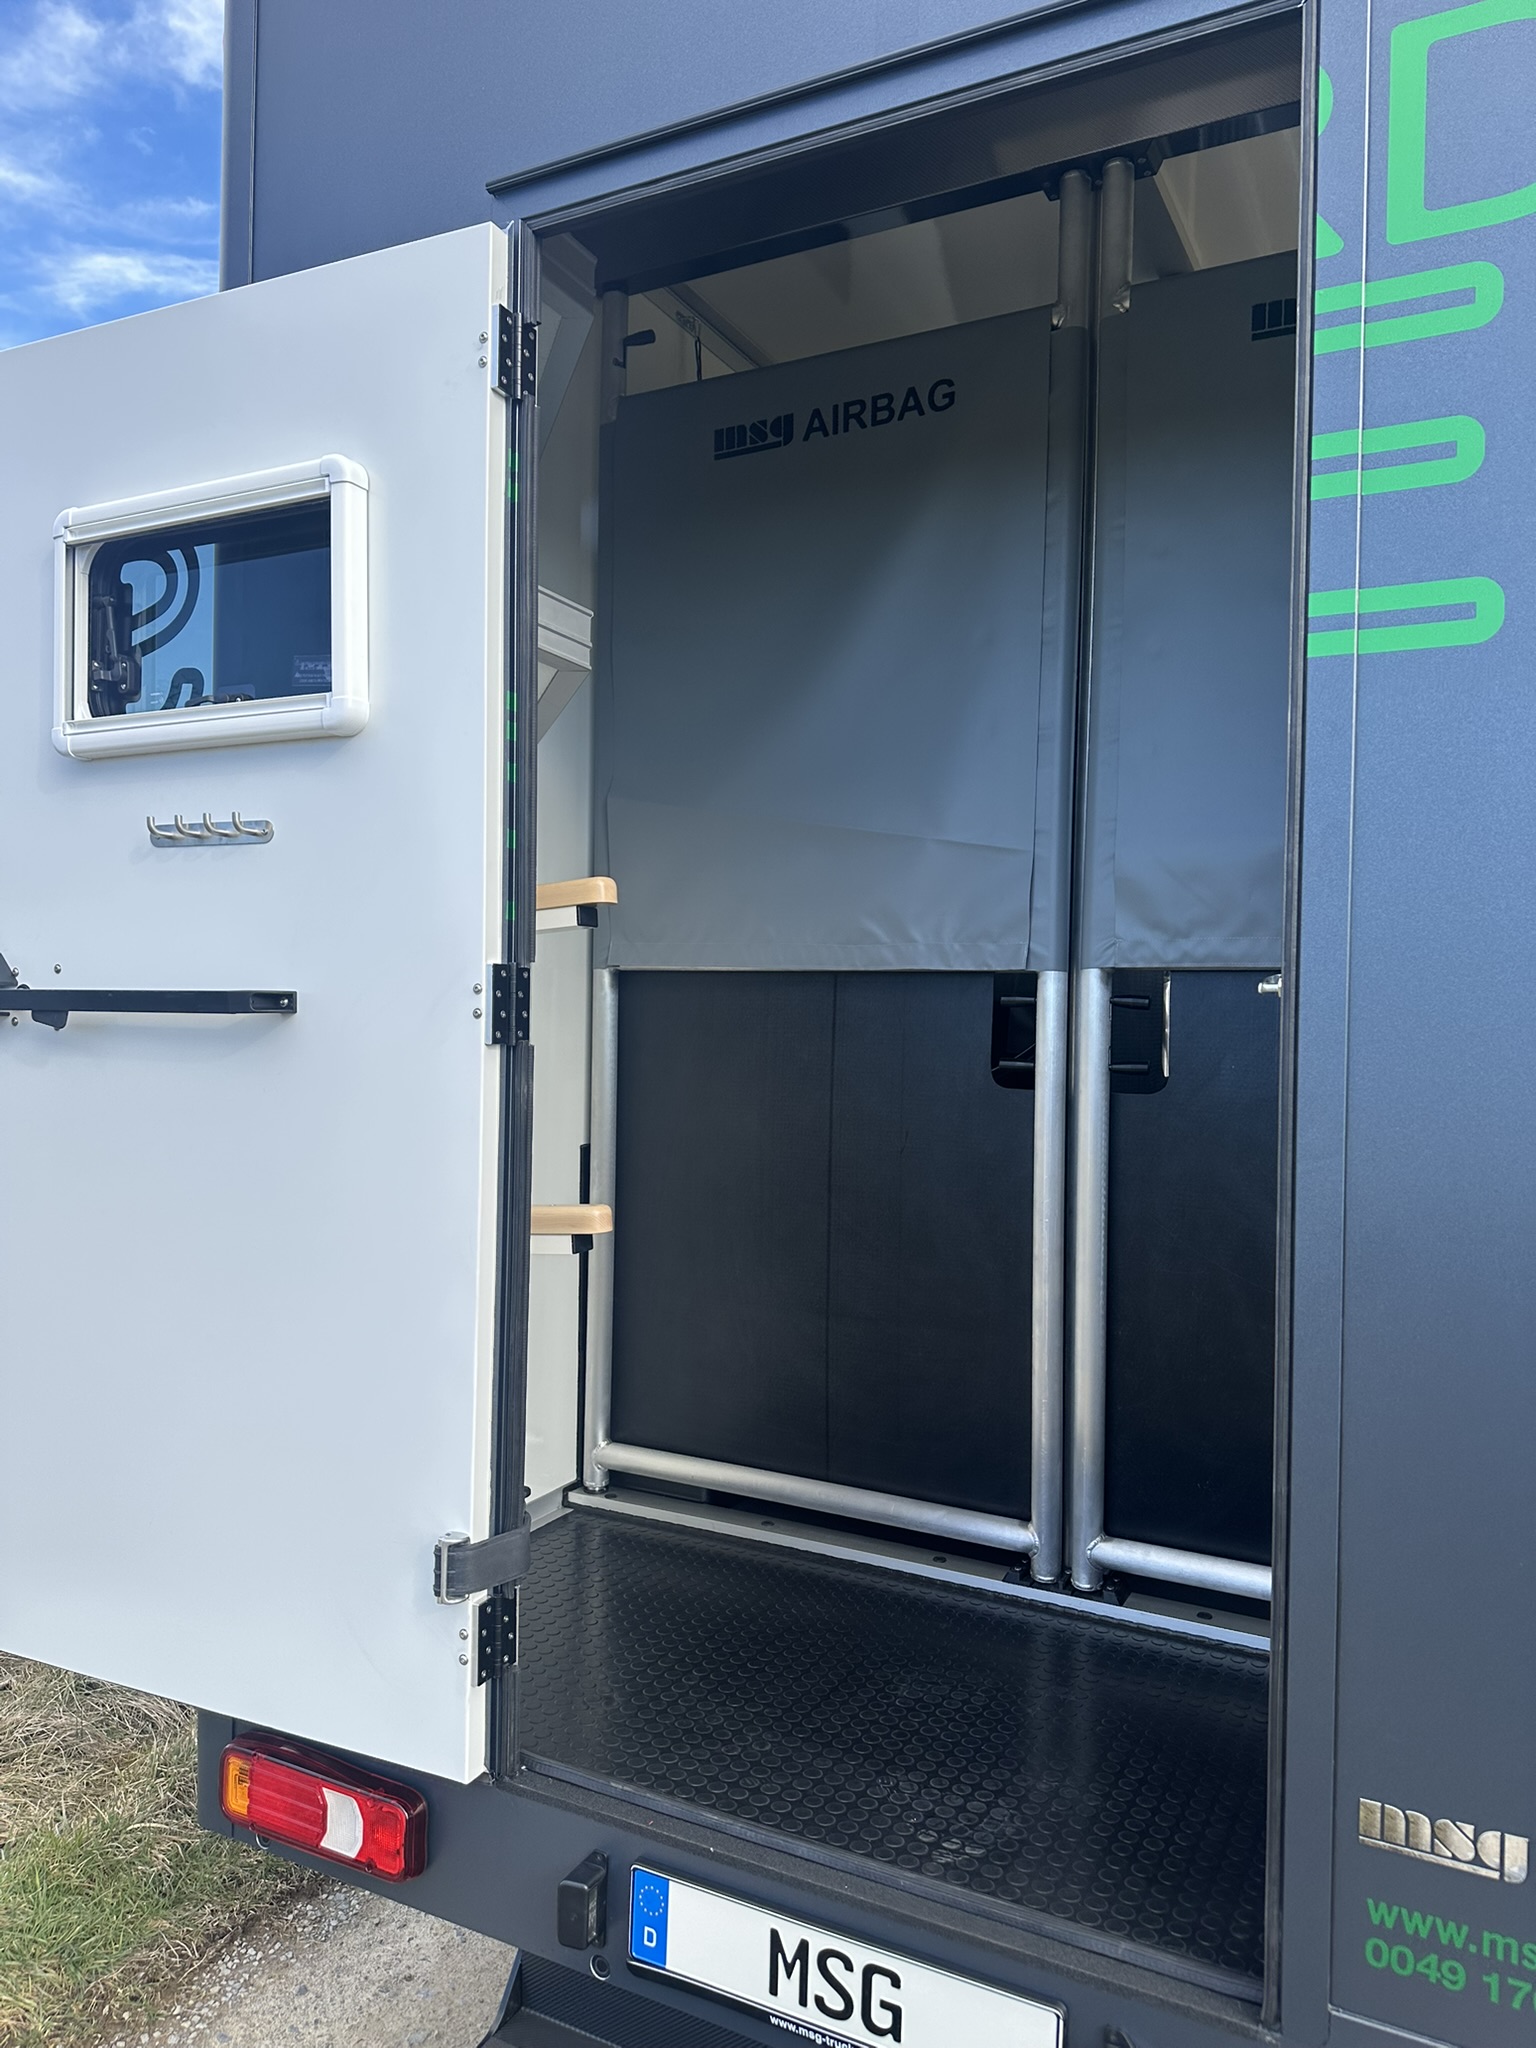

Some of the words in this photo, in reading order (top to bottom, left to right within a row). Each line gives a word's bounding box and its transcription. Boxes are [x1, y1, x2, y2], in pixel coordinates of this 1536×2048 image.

[714, 412, 795, 461] msg
[802, 378, 956, 442] AIRBAG
[1358, 1797, 1529, 1884] msg
[643, 1925, 657, 1948] D
[1364, 1937, 1467, 1992] 0049
[1482, 1972, 1536, 2011] 17
[769, 1927, 903, 2044] MSG
